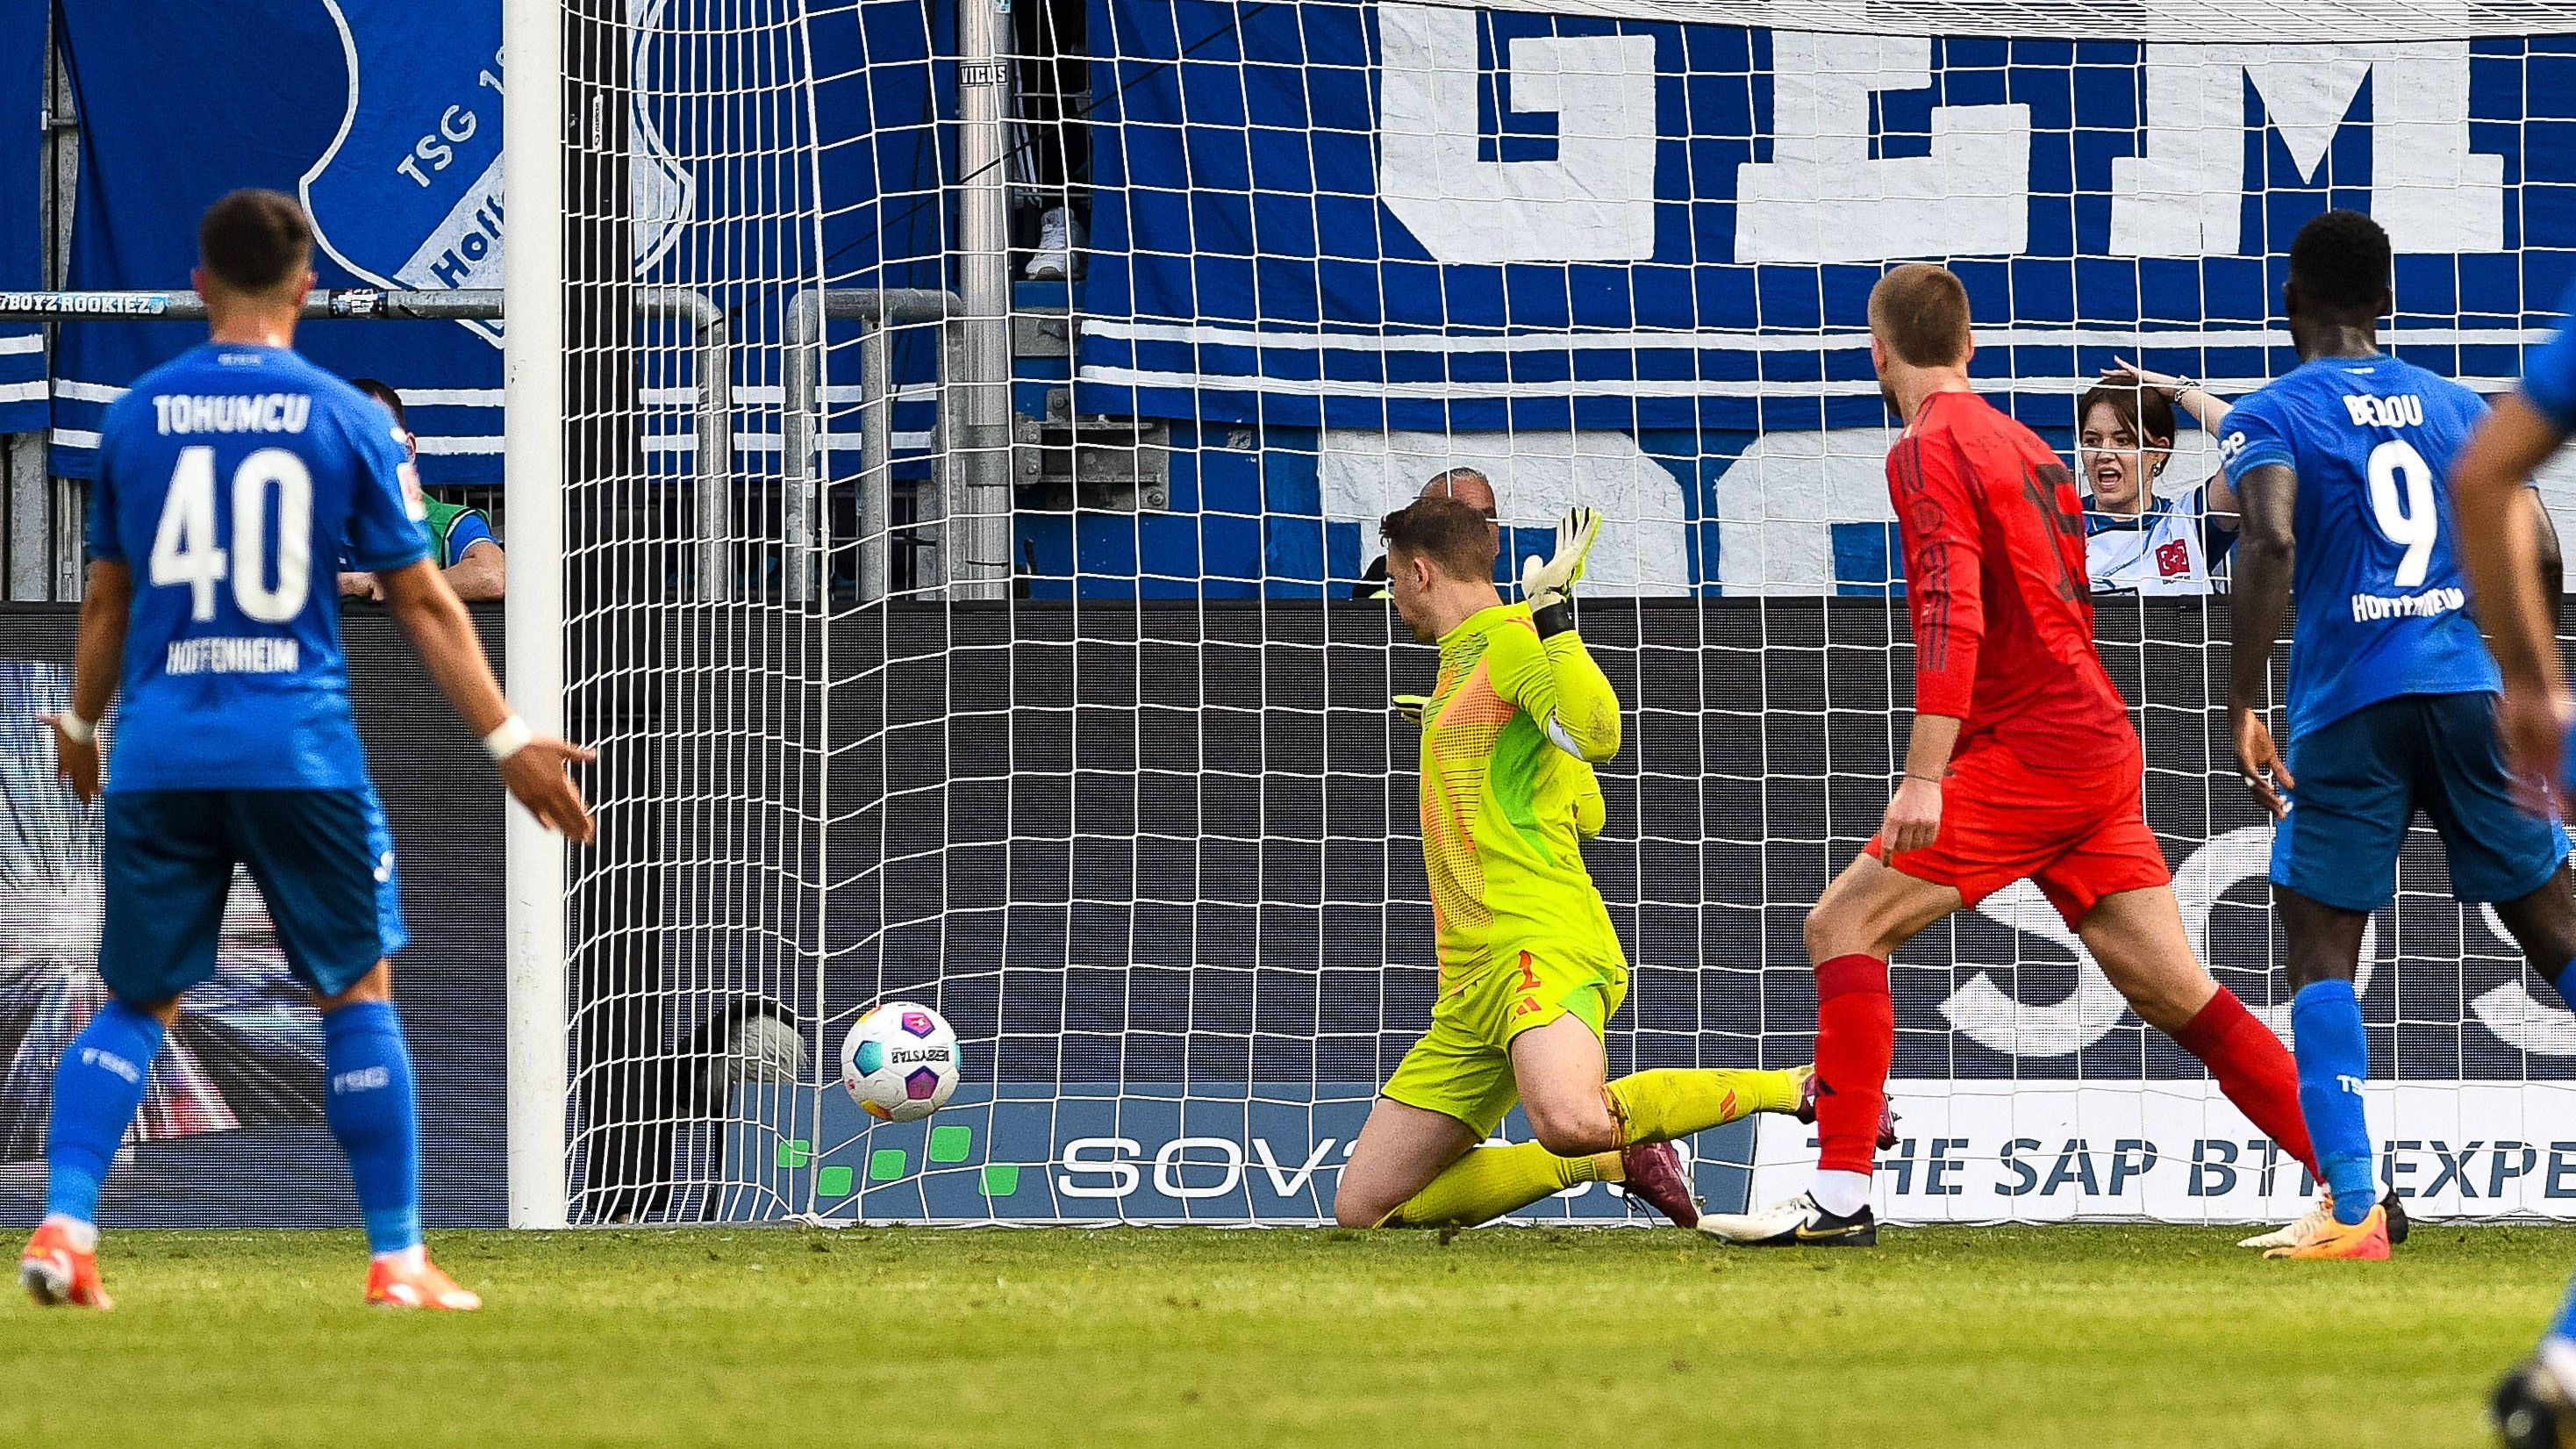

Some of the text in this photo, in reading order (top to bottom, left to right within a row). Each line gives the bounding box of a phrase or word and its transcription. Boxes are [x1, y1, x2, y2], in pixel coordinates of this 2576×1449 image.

[397, 104, 476, 188] TSG
[153, 393, 311, 435] TOHUMCU
[148, 445, 314, 622] 40
[2368, 439, 2438, 587] 9
[166, 638, 300, 676] HOFFENHEIM
[1516, 950, 1542, 993] 1
[1807, 1138, 1969, 1195] HE
[1994, 1138, 2158, 1196] SAP
